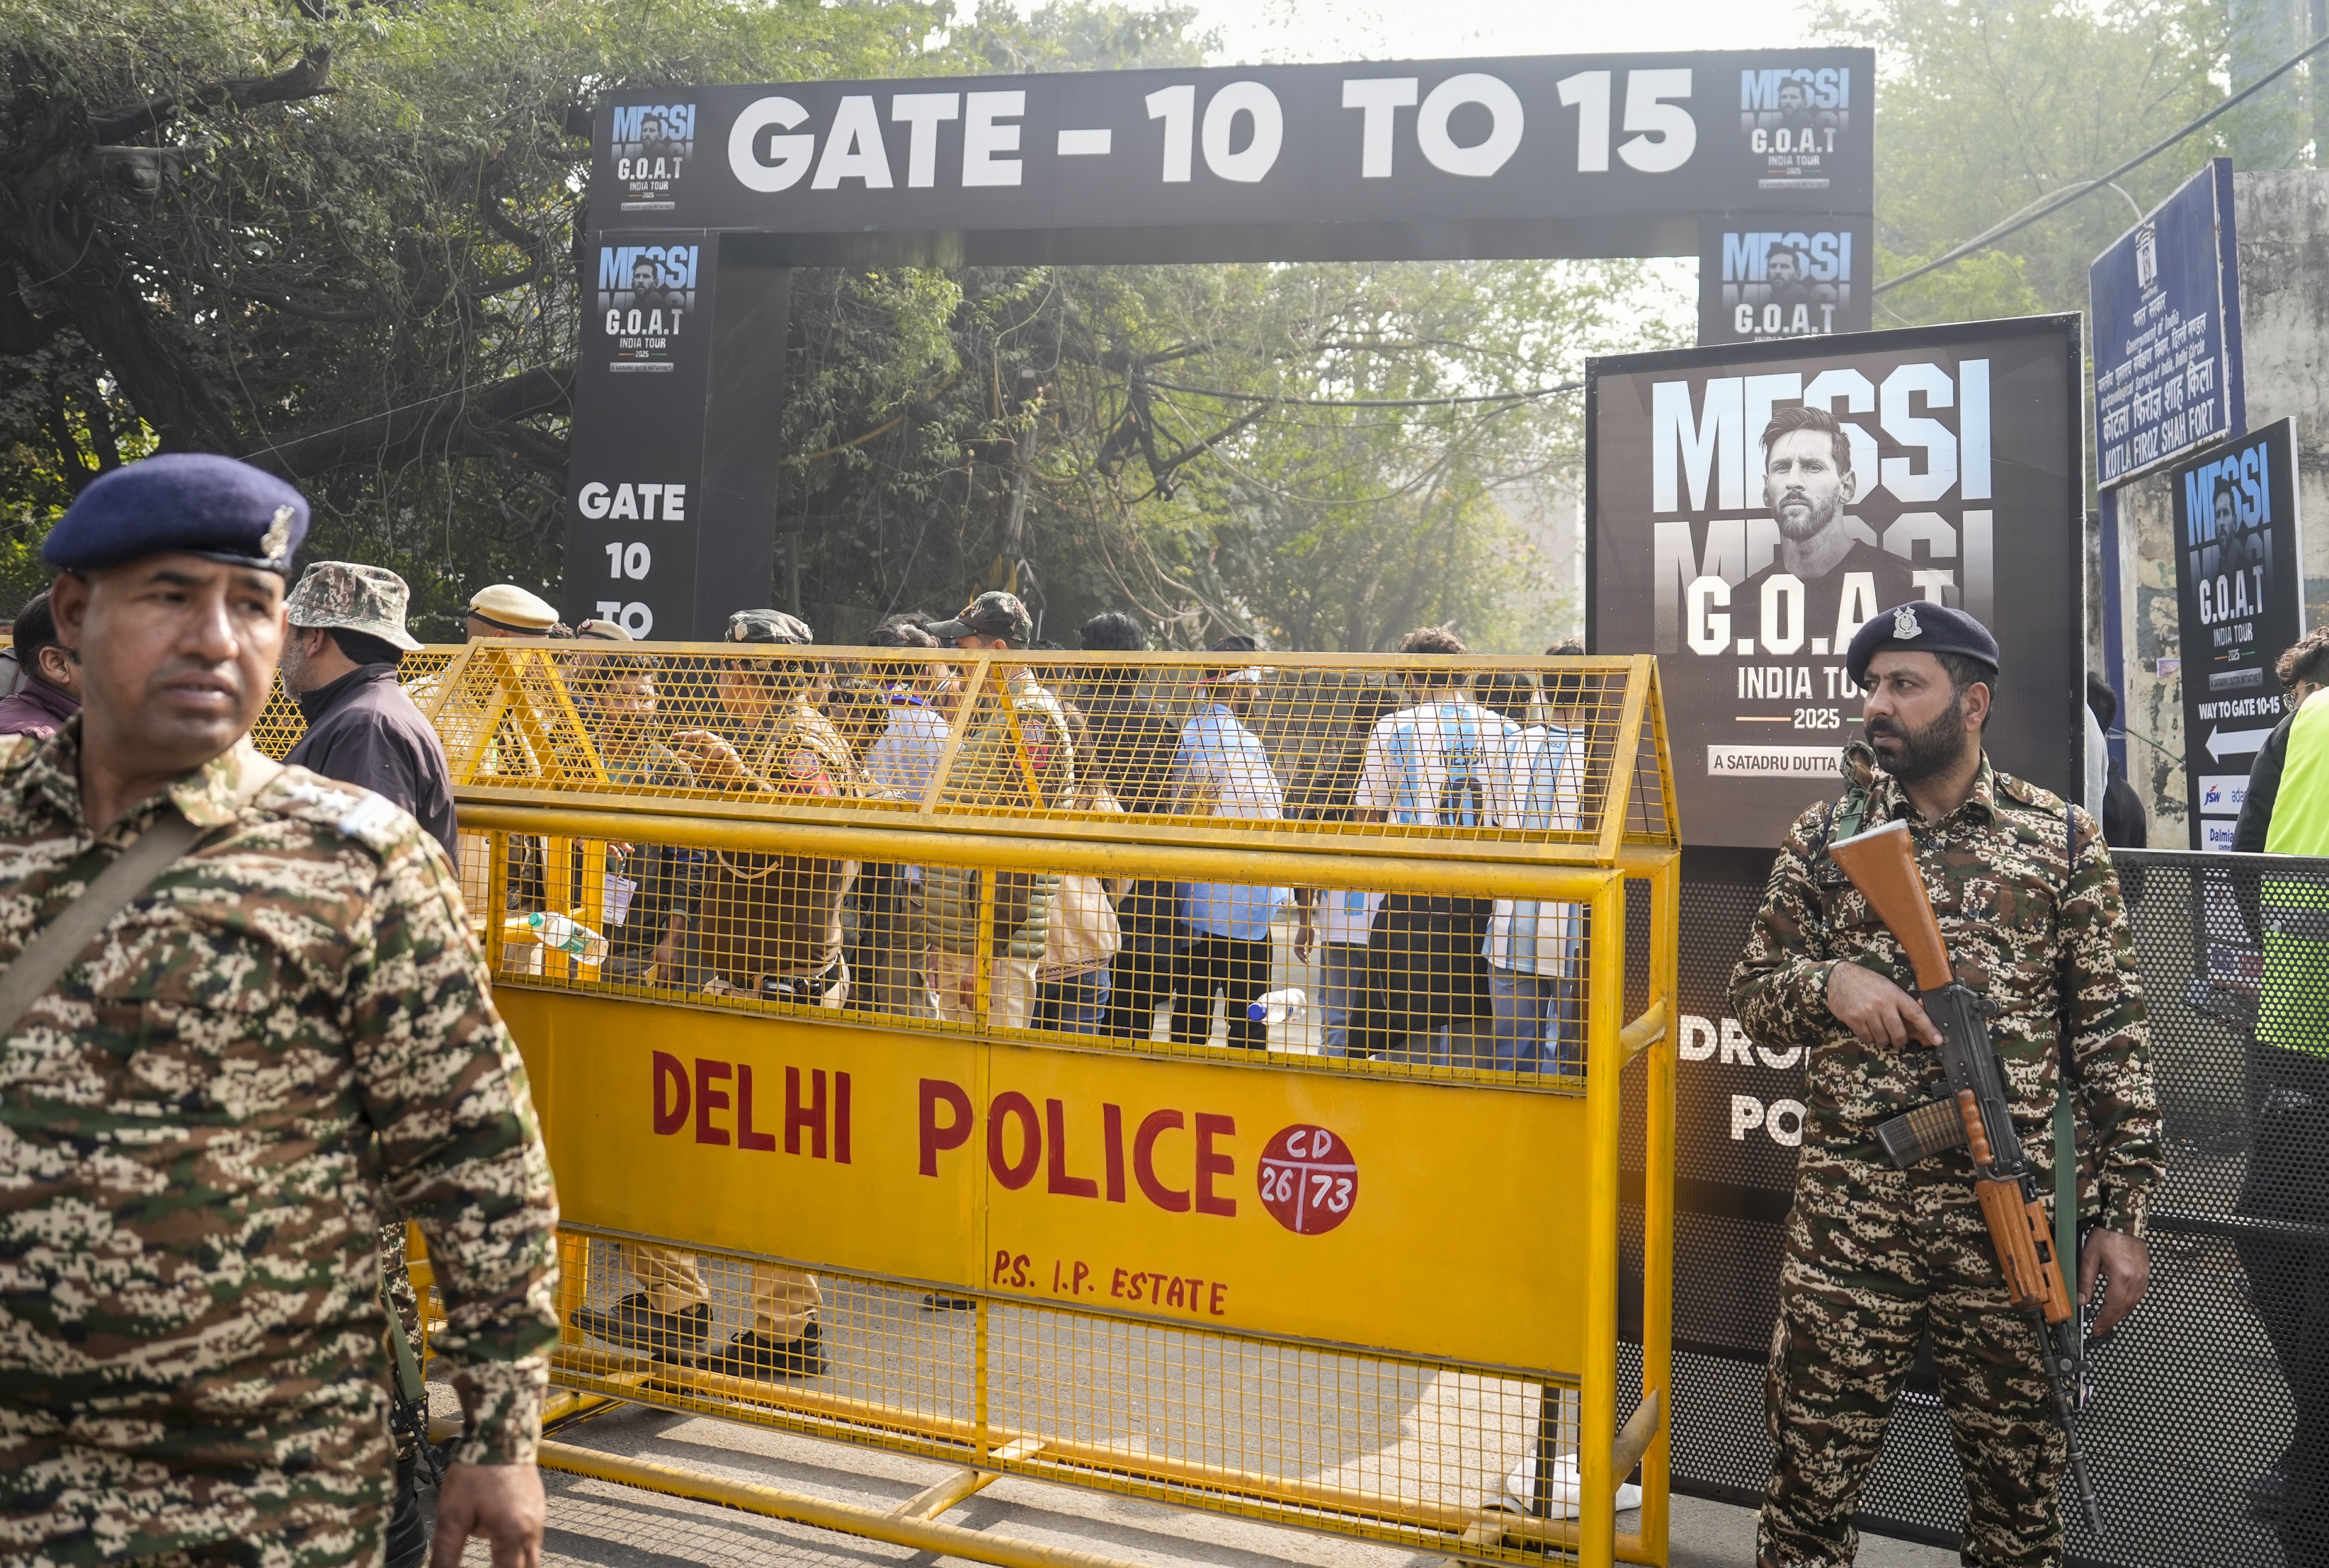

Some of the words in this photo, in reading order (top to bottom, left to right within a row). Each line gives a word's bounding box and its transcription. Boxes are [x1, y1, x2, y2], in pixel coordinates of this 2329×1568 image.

[1741, 67, 1849, 110] MESSI
[612, 104, 696, 142] MESSI
[728, 90, 1026, 192] GATE
[1058, 129, 1111, 155] -
[1145, 81, 1283, 182] 10
[1342, 73, 1524, 178] TO
[1556, 68, 1697, 172] 15
[1752, 127, 1837, 153] G.O.A.T
[618, 156, 683, 180] G.O.A.T
[1768, 155, 1793, 166] INDIA
[1796, 154, 1820, 165] TOUR
[630, 182, 648, 190] INDIA
[651, 181, 668, 190] TOUR
[599, 246, 699, 289] MESSI
[1722, 232, 1852, 281] MESSI
[606, 309, 683, 335] G.O.A.T
[1735, 303, 1835, 333] G.O.A.T
[2133, 306, 2147, 327] भारत
[2148, 291, 2167, 318] सरकार
[620, 338, 642, 348] INDIA
[645, 337, 666, 348] TOUR
[2126, 322, 2157, 355] Government
[2158, 317, 2163, 335] of
[2165, 308, 2179, 331] India
[2101, 379, 2134, 411] Archaeological
[2136, 369, 2154, 391] Survey
[2154, 364, 2160, 380] of
[2162, 357, 2175, 376] India,
[2176, 346, 2188, 368] Delhi
[2189, 338, 2205, 360] Circle
[2103, 404, 2129, 443] कोटला
[2164, 373, 2183, 413] शाह
[2186, 356, 2214, 400] किला
[1652, 358, 1992, 513] MESSI
[2105, 439, 2132, 479] KOTLA
[2134, 426, 2159, 466] FIROZ
[2162, 412, 2186, 453] SHAH
[2188, 398, 2214, 440] FORT
[579, 482, 685, 520] GATE
[2185, 442, 2271, 546] MESSI
[605, 542, 651, 580] 10
[2199, 565, 2263, 625] G.O.A.T
[596, 601, 653, 639] TO
[2214, 626, 2233, 647] INDIA
[2234, 622, 2253, 643] TOUR
[2228, 648, 2240, 661] 2025
[1738, 667, 1813, 699] INDIA
[1823, 667, 1868, 699] TO
[1794, 708, 1840, 728] 2025
[2199, 702, 2218, 719] WAY
[2218, 701, 2231, 718] TO
[2232, 698, 2255, 717] GATE
[2256, 696, 2280, 715] 10-15
[1714, 755, 1724, 769] A
[1727, 755, 1789, 770] SATADRU
[1793, 756, 1837, 771] DUTTA
[2203, 792, 2221, 806] JSW
[2210, 828, 2234, 843] Dalmia
[653, 1050, 852, 1164] DELHI
[919, 1078, 1236, 1217] POLICE
[1286, 1129, 1333, 1159] CD
[1262, 1166, 1293, 1202] 26
[1312, 1175, 1353, 1213] 73
[993, 1250, 1035, 1287] P.S.
[1053, 1259, 1095, 1295] I.P.
[1111, 1267, 1228, 1315] ESTATE
